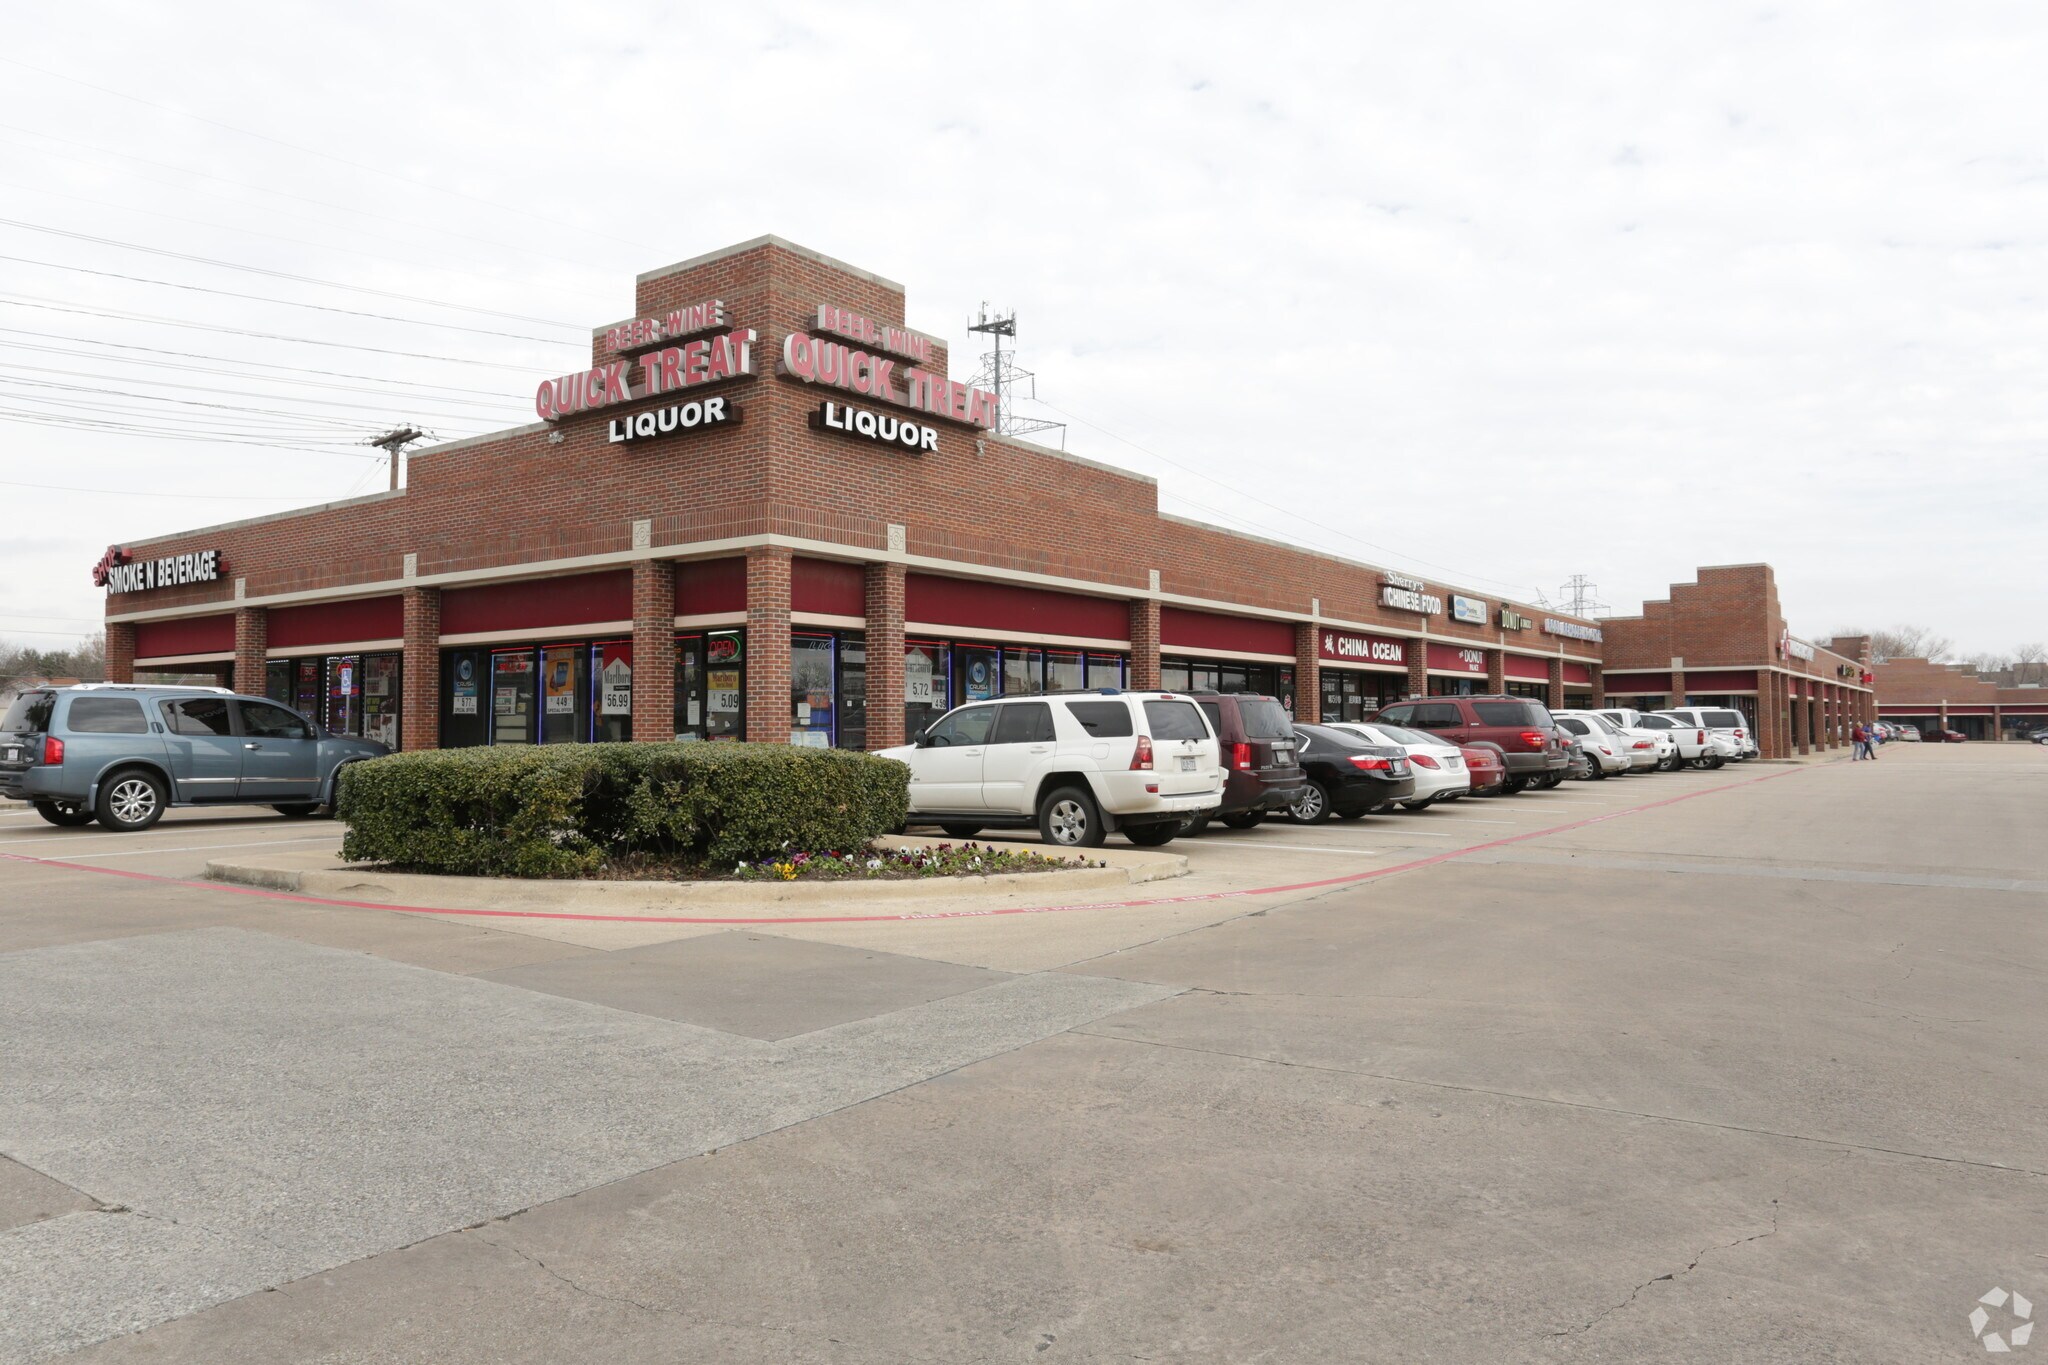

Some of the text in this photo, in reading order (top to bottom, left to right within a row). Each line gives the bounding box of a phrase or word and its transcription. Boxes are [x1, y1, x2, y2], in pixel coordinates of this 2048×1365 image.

[536, 328, 757, 421] QUICK TREAT
[783, 332, 999, 430] QUICK TREAT
[609, 397, 726, 444] LIQUOR
[825, 401, 938, 451] LIQUOR
[92, 545, 116, 587] SHOP
[108, 550, 217, 594] SMOKE N BEVERAGE
[1387, 587, 1441, 615] CHINESE FOOD
[709, 640, 735, 657] OPEN
[1338, 637, 1369, 657] CHINA
[1372, 642, 1402, 661] OCEAN
[1464, 649, 1483, 665] DONUT
[912, 682, 929, 696] 5.72
